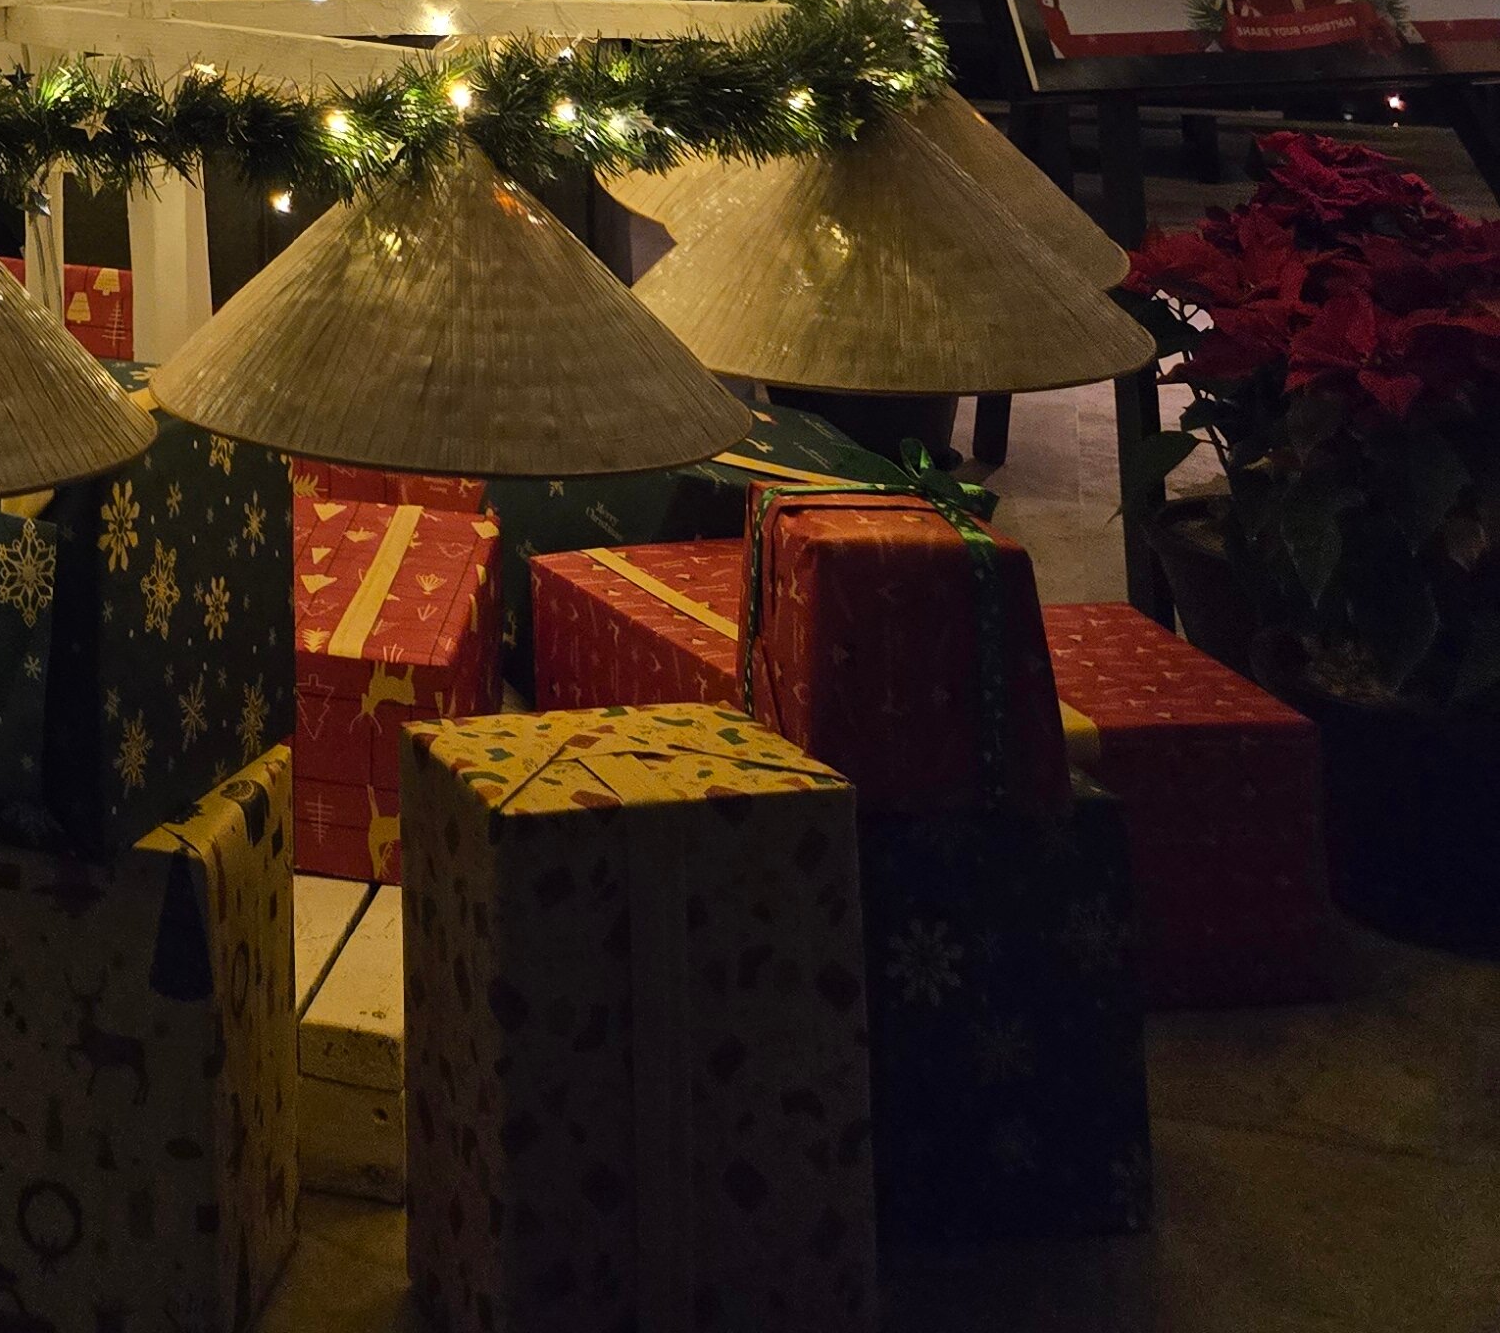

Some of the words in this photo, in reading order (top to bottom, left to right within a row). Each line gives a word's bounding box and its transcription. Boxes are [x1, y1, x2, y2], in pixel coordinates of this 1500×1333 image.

[1236, 25, 1271, 37] SHARE
[1272, 26, 1300, 37] YOUR
[1302, 17, 1357, 35] CHRISTMAS
